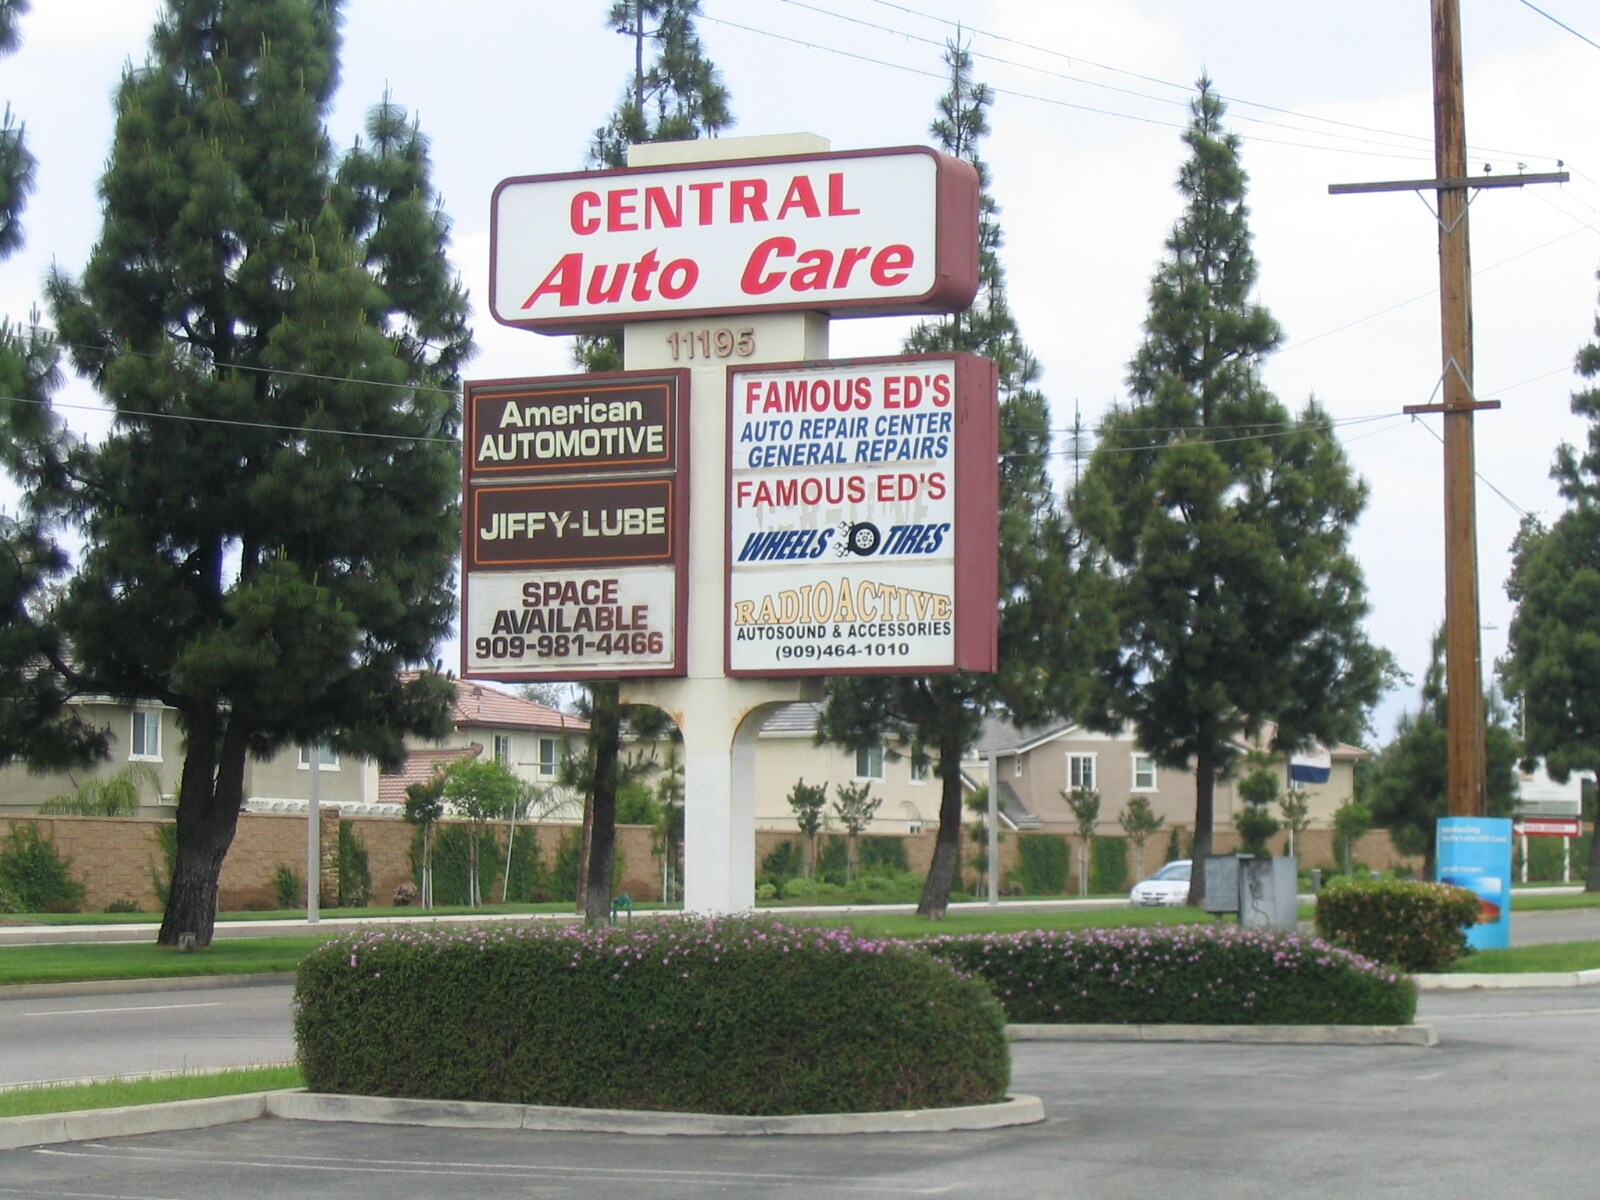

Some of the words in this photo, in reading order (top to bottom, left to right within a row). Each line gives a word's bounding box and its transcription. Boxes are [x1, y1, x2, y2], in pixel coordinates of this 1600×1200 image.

[570, 172, 861, 235] CENTRAL
[521, 247, 699, 309] Auto
[740, 236, 914, 295] Care
[666, 327, 755, 360] 11195
[746, 377, 872, 414] FAMOUS
[884, 374, 951, 409] ED'S
[500, 397, 643, 428] American
[740, 420, 793, 442] AUTO
[799, 416, 869, 440] REPAIR
[874, 412, 952, 436] CENTER
[478, 425, 664, 461] AUTOMOTIVE
[748, 441, 847, 468] GENERAL
[855, 436, 949, 462] REPAIRS
[737, 476, 866, 508] FAMOUS
[877, 472, 946, 502] ED'S
[480, 507, 666, 540] JIFFY-LUBE
[737, 528, 835, 562] WHEELS
[879, 523, 951, 555] TIRES
[522, 579, 619, 607] SPACE
[735, 577, 952, 626] RADIOACTIVE
[491, 605, 649, 635] AVAILABLE
[736, 625, 827, 641] AUTOSOUND
[832, 625, 842, 638] &
[848, 621, 952, 637] ACCESSORIES
[475, 631, 664, 660] 909-981-4466
[775, 643, 910, 661] (909)464-1010
